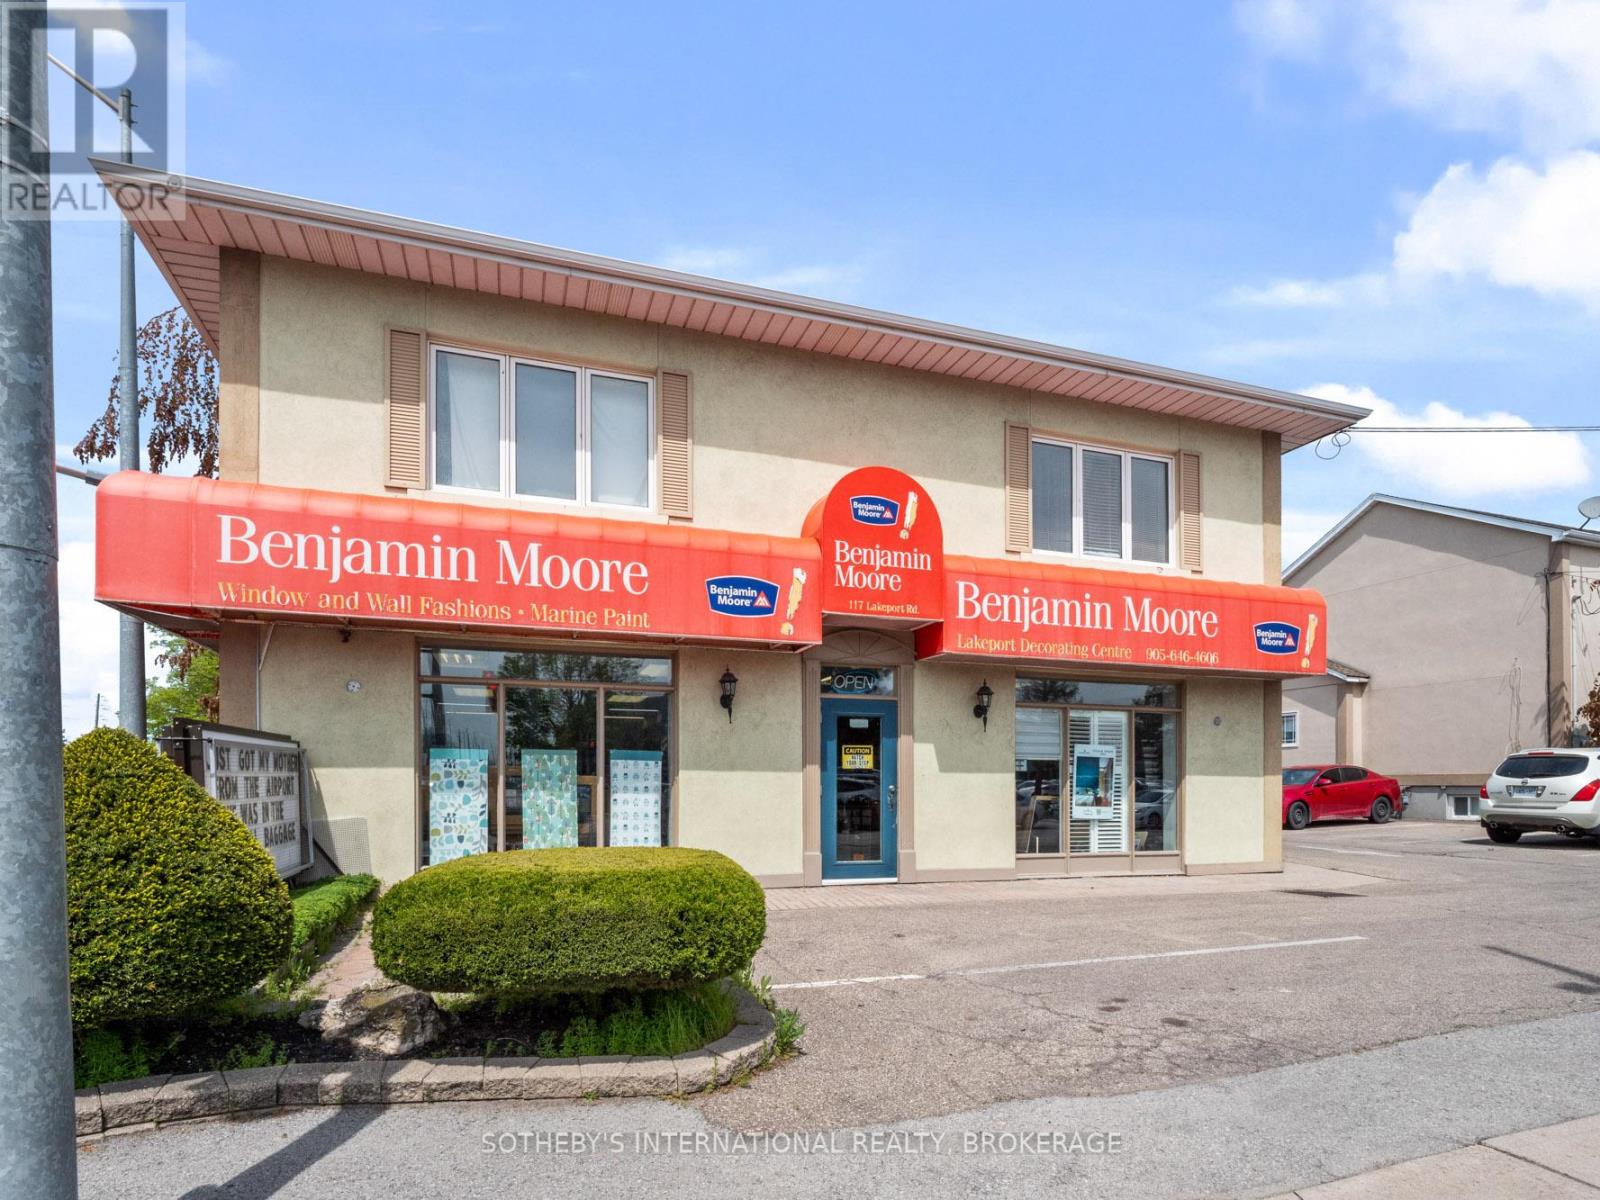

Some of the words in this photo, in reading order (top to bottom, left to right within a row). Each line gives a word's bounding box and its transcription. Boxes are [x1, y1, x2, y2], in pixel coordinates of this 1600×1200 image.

[852, 501, 885, 512] Benjamin
[857, 509, 881, 518] Moore
[216, 513, 479, 584] Benjamin
[495, 539, 650, 596] Moore
[833, 540, 932, 572] Benjamin
[834, 564, 902, 592] Moore
[709, 584, 757, 598] Benjamin
[717, 595, 752, 607] Moore
[217, 581, 310, 607] Window
[318, 592, 359, 610] and
[366, 592, 412, 615] Wall
[419, 597, 512, 620] Fashions
[530, 603, 597, 626] Marine
[603, 608, 650, 629] Paint
[848, 600, 864, 611] 117
[867, 602, 904, 613] Lakeport
[955, 581, 1113, 632] Benjamin
[1123, 596, 1219, 638] Moore
[1256, 629, 1287, 640] Benjamin
[957, 634, 1016, 655] Lakeport
[1020, 638, 1089, 659] Decorating
[1092, 644, 1132, 659] Centre
[834, 674, 874, 689] OPEN
[239, 749, 255, 771] GOT
[244, 776, 260, 799] THE
[266, 776, 295, 798] AIRPORT
[263, 822, 296, 848] BAGGAGE
